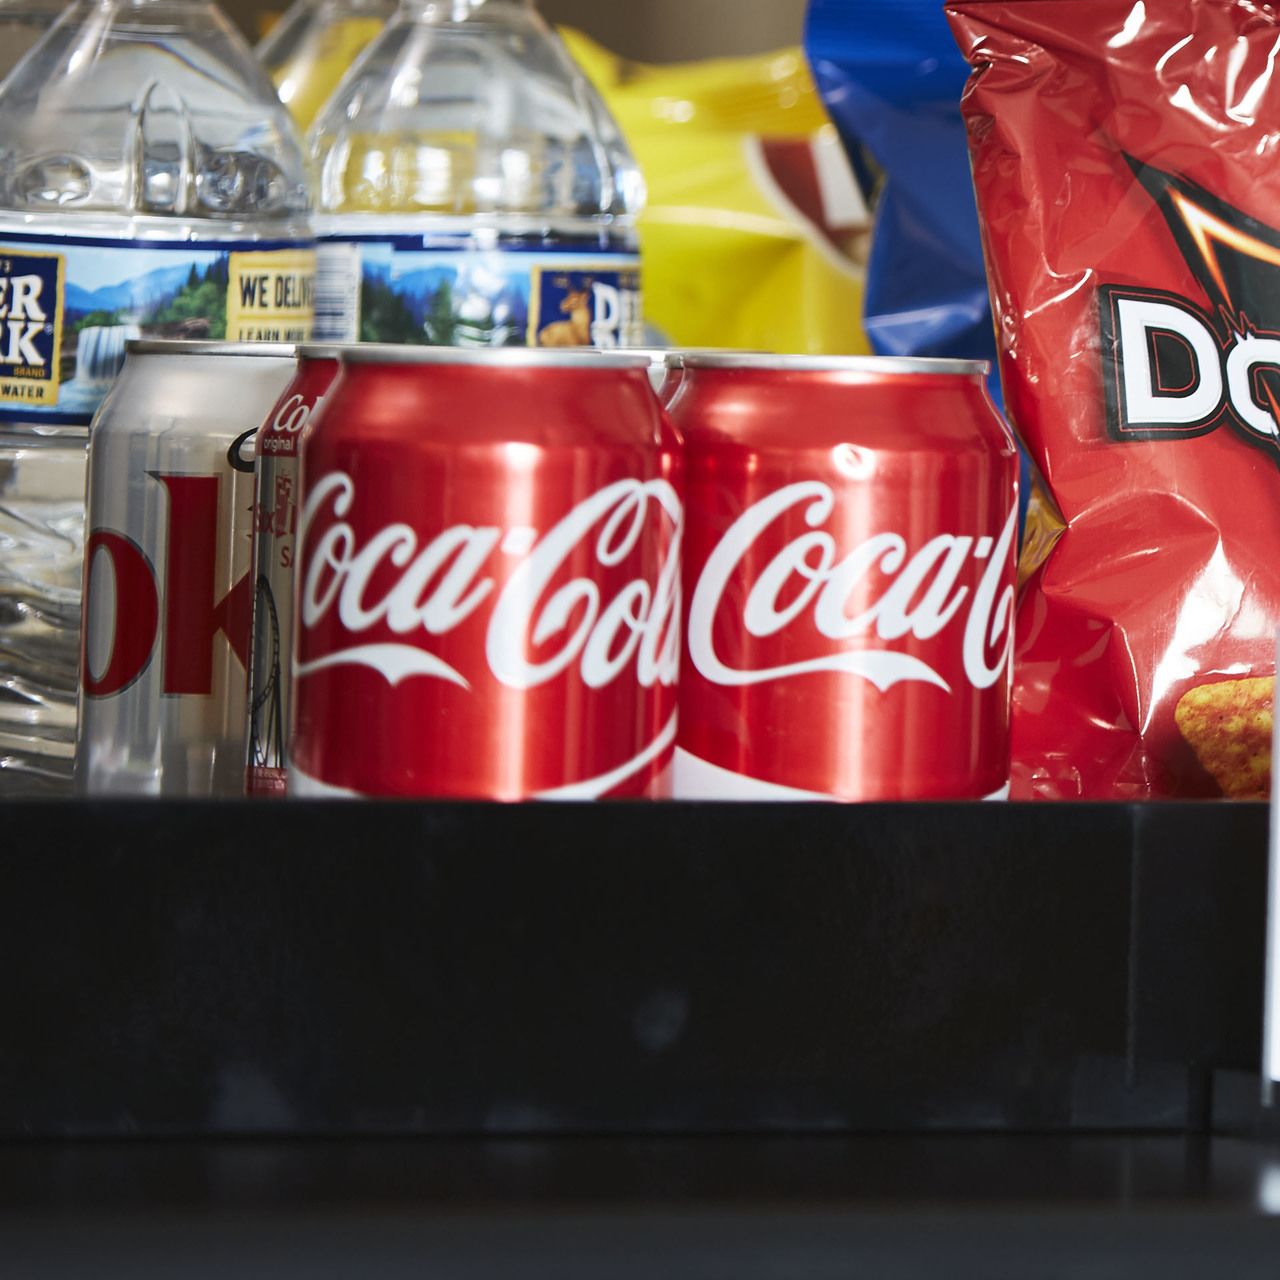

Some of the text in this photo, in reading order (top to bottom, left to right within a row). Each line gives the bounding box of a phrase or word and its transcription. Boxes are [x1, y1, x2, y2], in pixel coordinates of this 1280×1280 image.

[239, 275, 269, 308] WE
[1, 384, 44, 399] WATER
[263, 435, 295, 453] original
